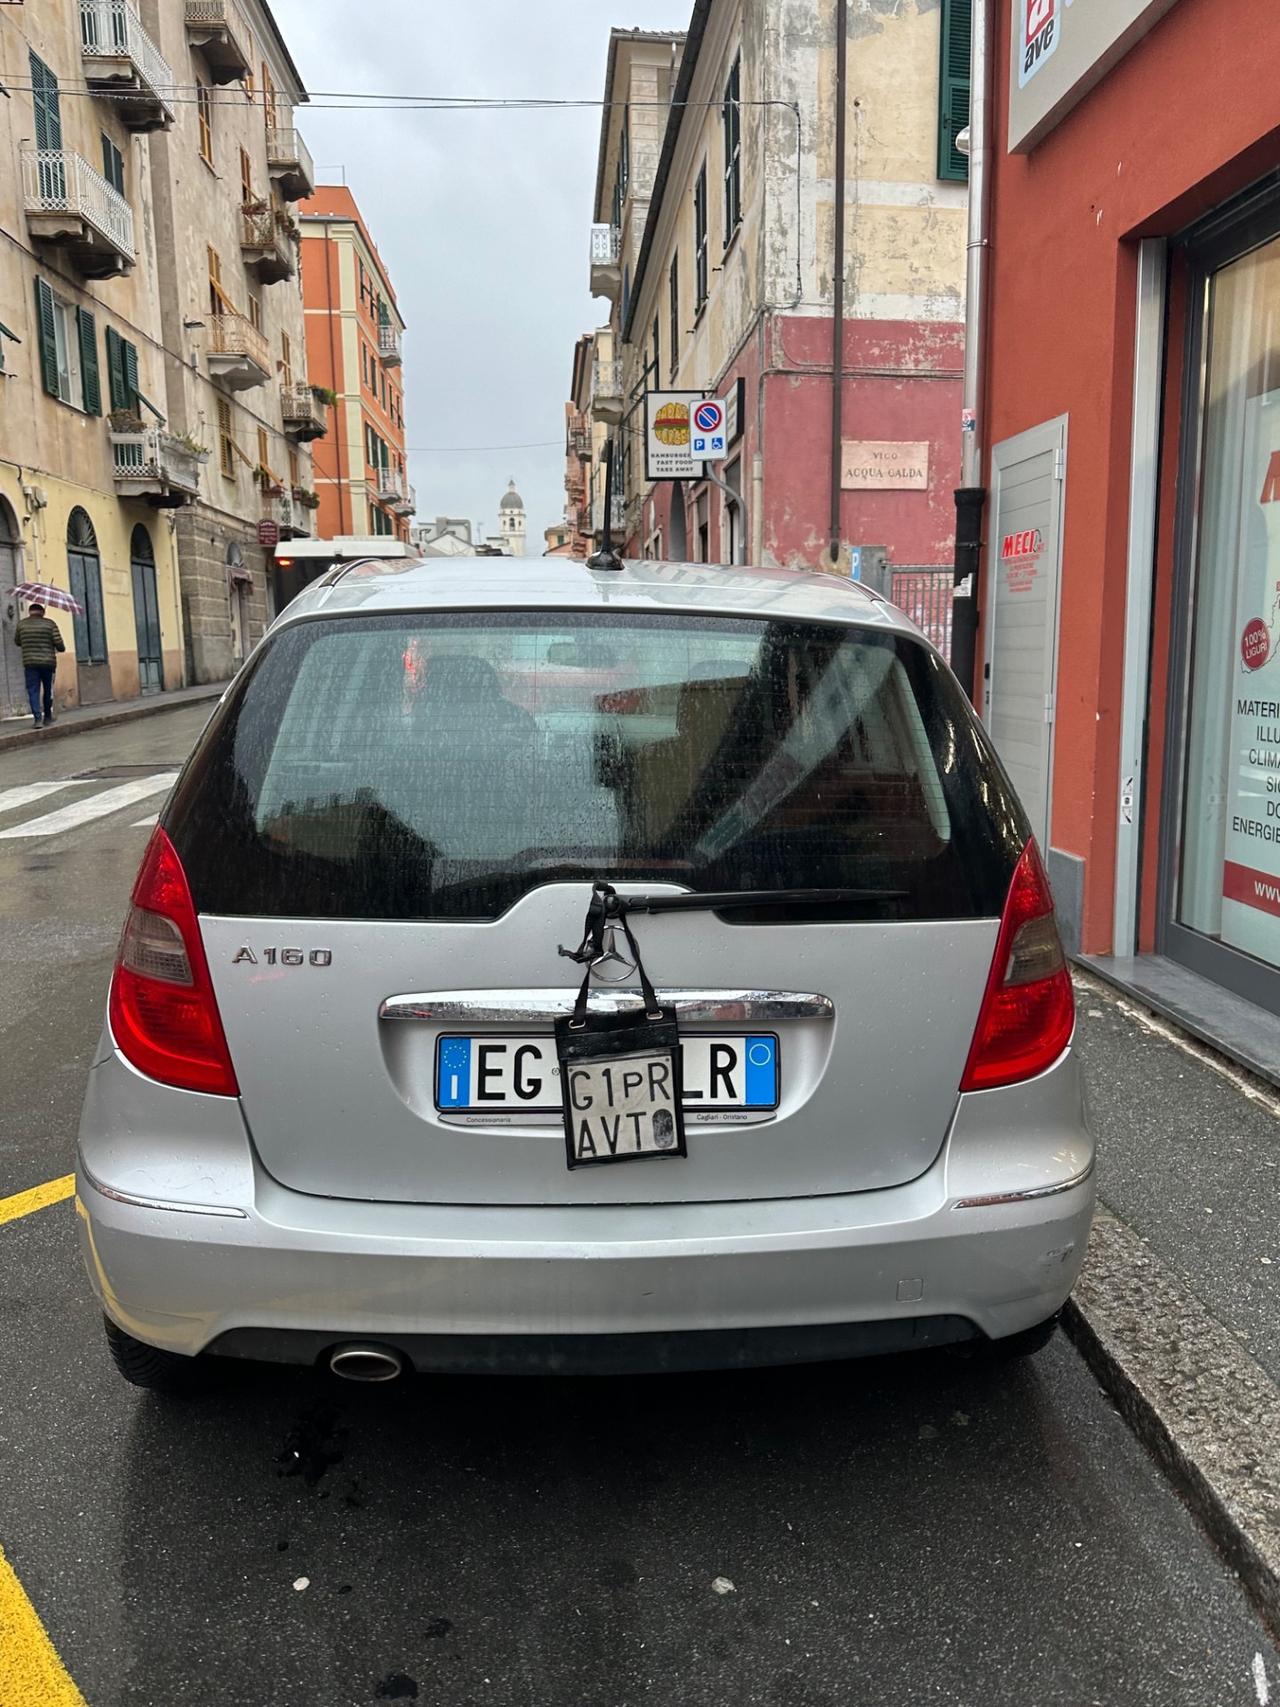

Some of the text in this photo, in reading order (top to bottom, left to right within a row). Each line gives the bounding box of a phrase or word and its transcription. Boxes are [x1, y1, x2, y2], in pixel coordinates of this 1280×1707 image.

[1024, 19, 1054, 73] ave
[696, 441, 703, 450] P
[873, 452, 898, 460] VICO
[847, 468, 883, 479] ACQUA
[1245, 627, 1267, 647] 100%
[1246, 641, 1268, 659] LIGURI
[1237, 699, 1280, 718] MATERI
[1267, 776, 1280, 792] SI
